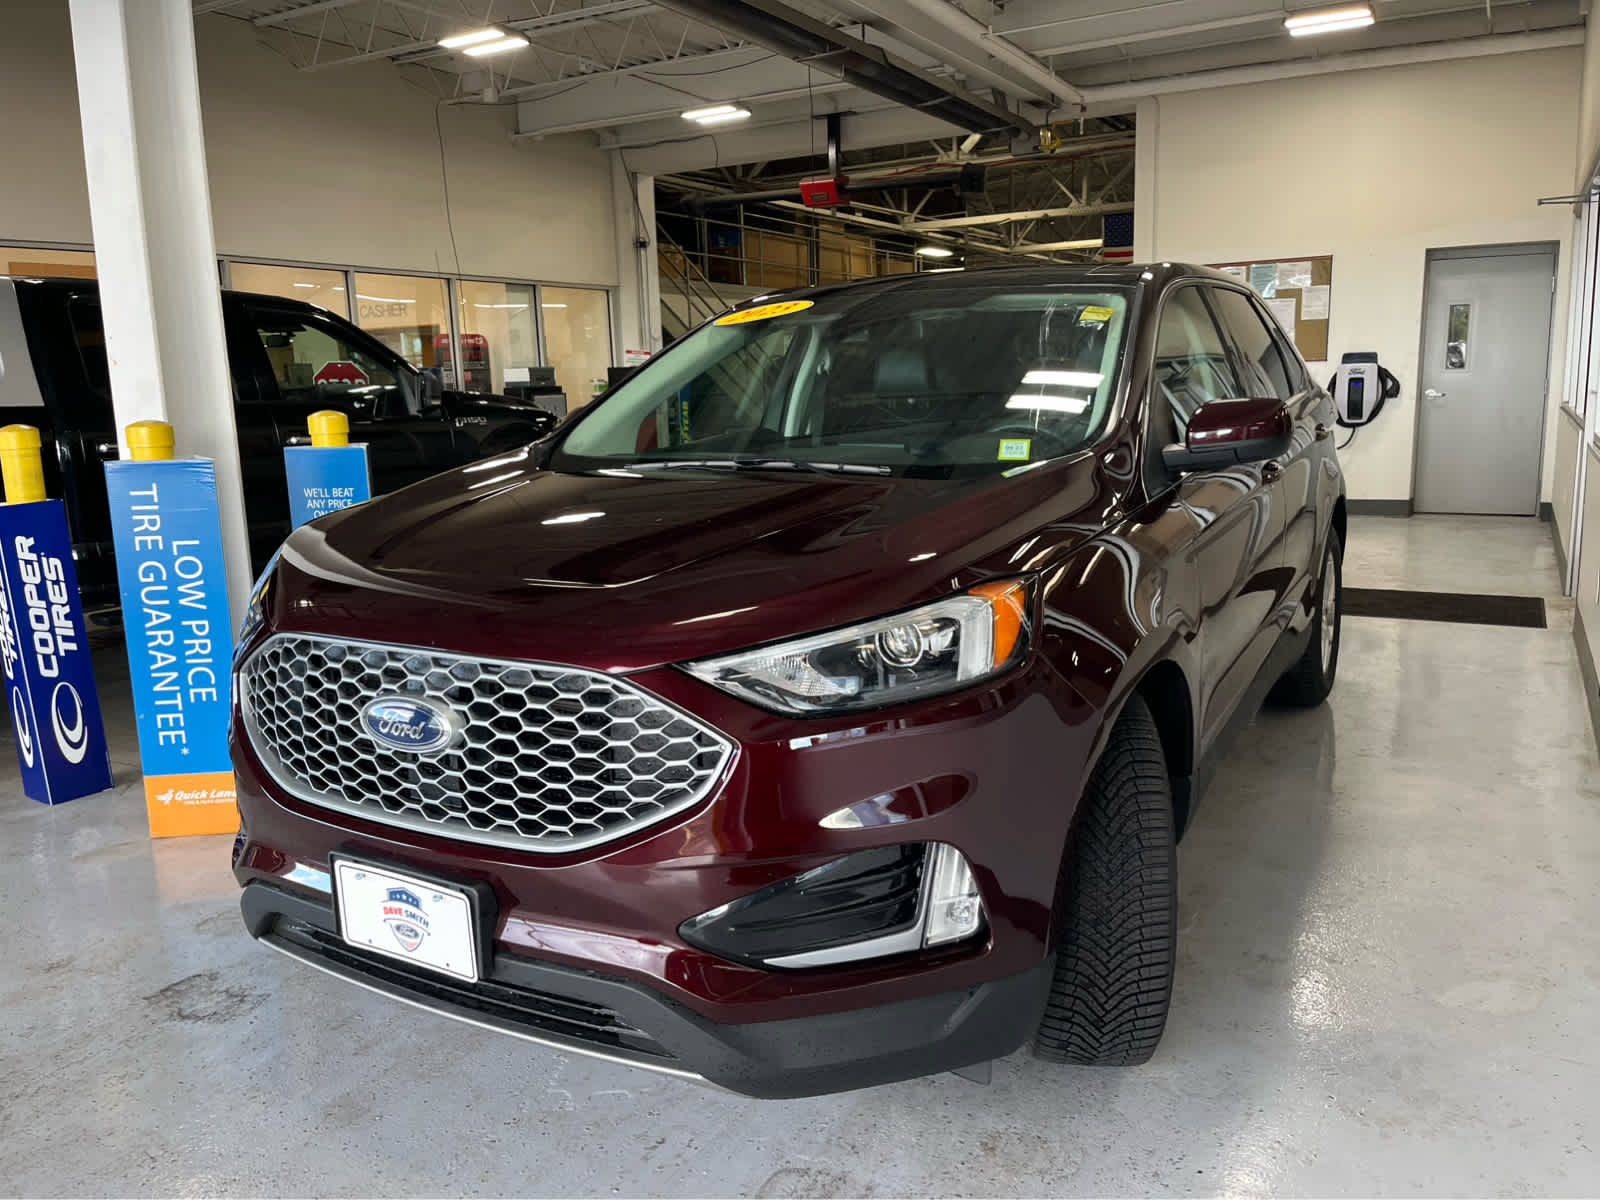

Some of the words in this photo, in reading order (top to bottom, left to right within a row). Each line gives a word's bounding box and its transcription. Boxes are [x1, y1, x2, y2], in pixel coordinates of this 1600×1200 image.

[129, 482, 164, 552] TIRE
[303, 487, 331, 498] WE'LL
[332, 487, 355, 498] BEAT
[306, 499, 326, 509] ANY
[327, 499, 353, 510] PRICE
[172, 540, 208, 611] LOW
[14, 535, 59, 678] COOPER
[42, 556, 78, 657] TIRES
[181, 620, 218, 703] PRICE
[378, 709, 427, 740] Ford
[175, 790, 208, 801] Quick
[383, 906, 403, 917] DAVE
[404, 909, 430, 929] SMITH
